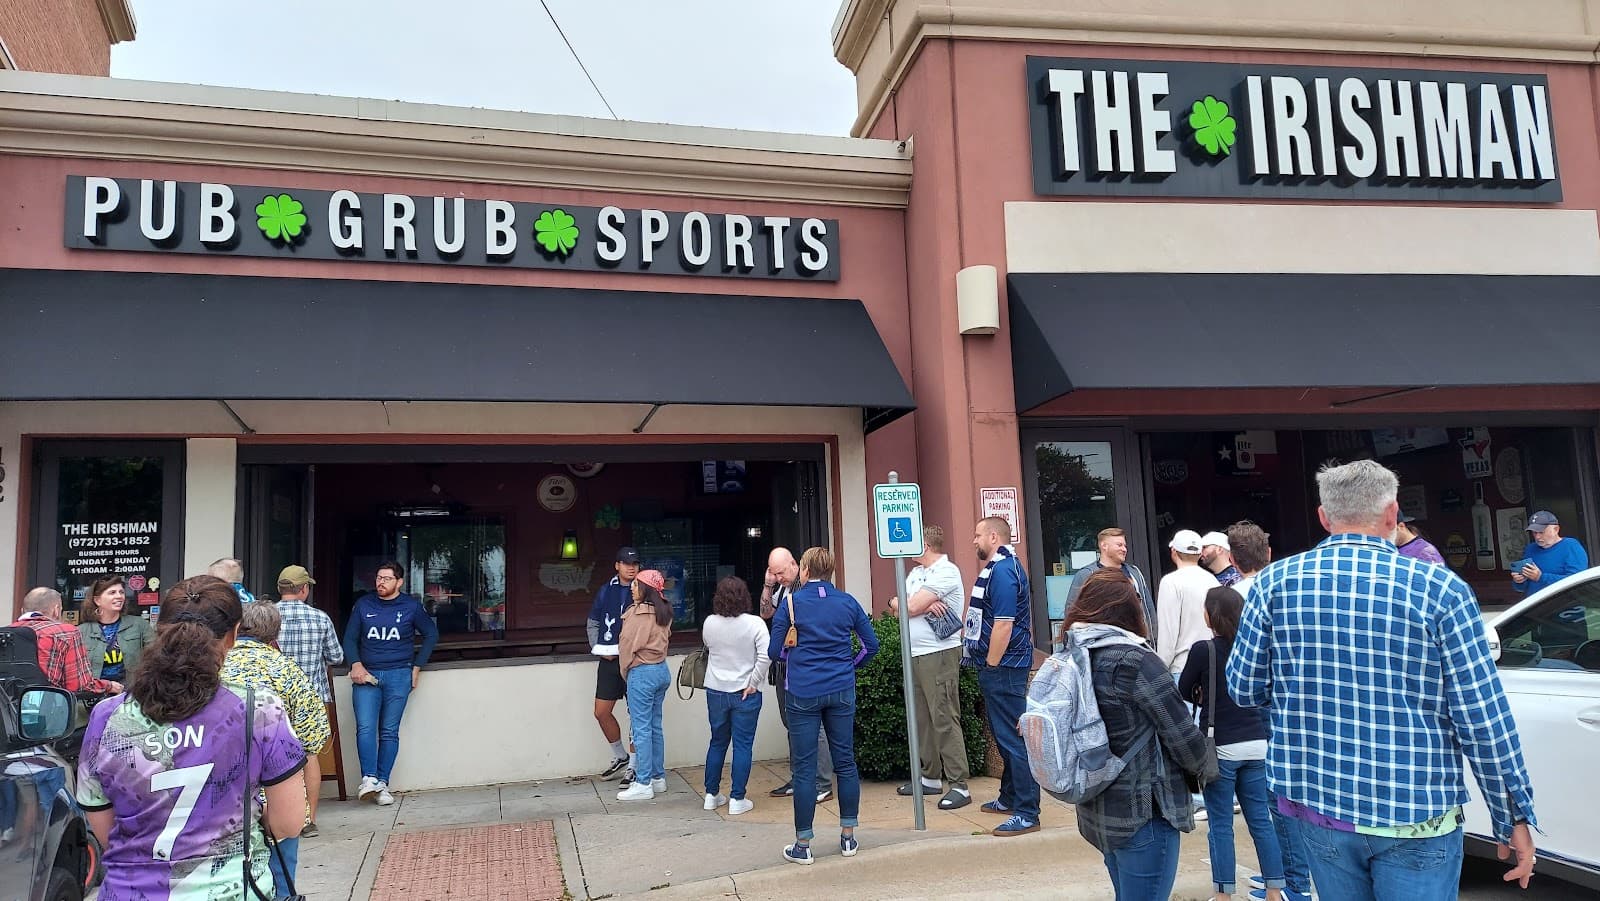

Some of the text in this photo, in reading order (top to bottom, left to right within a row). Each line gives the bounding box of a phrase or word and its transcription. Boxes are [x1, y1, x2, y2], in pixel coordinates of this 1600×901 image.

[1048, 68, 1556, 180] THE IRISHMAN
[83, 176, 829, 271] PUB GRUB SPORTS
[1465, 460, 1490, 472] TEXAS
[877, 490, 917, 501] RESERVED
[985, 491, 1014, 499] ADDITIONAL
[882, 503, 915, 513] PARKING
[989, 502, 1011, 510] PARKING
[62, 521, 158, 535] THE IRISHMAN
[68, 535, 151, 549] (972)733-1852
[68, 558, 108, 566] MONDAY
[114, 556, 151, 564] SUNDAY
[70, 566, 108, 575] 11:00AM
[114, 565, 146, 573] 2:00AM
[367, 626, 401, 641] AIA
[144, 724, 205, 756] SON
[150, 762, 215, 861] 7
